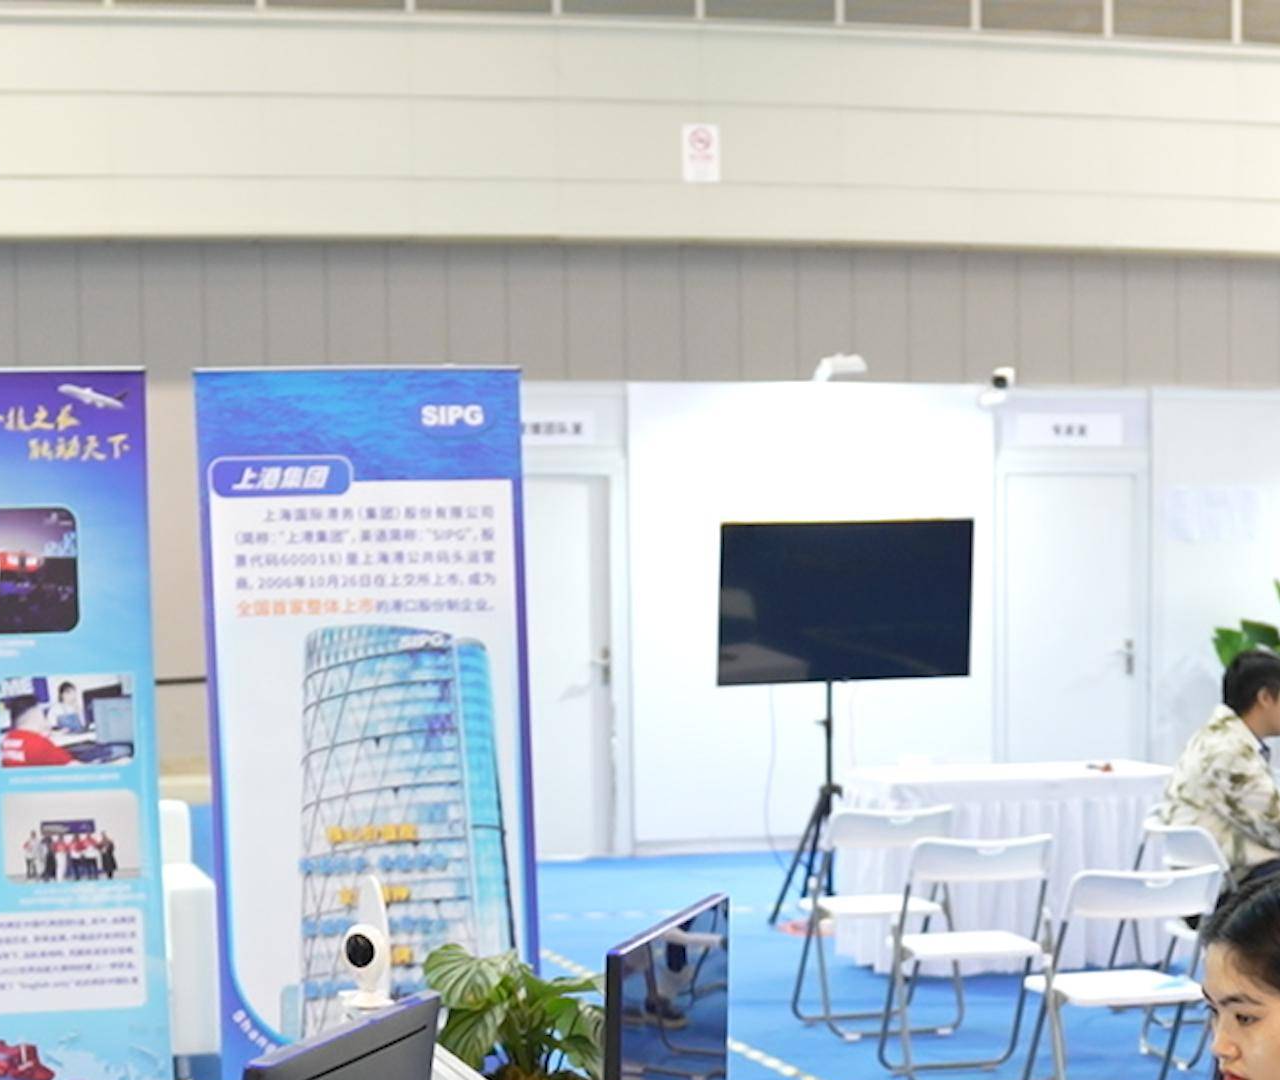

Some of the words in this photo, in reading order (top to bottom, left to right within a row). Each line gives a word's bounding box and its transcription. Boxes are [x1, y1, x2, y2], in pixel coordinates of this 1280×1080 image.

[421, 405, 485, 427] SIPG
[231, 464, 331, 491] 上港集团
